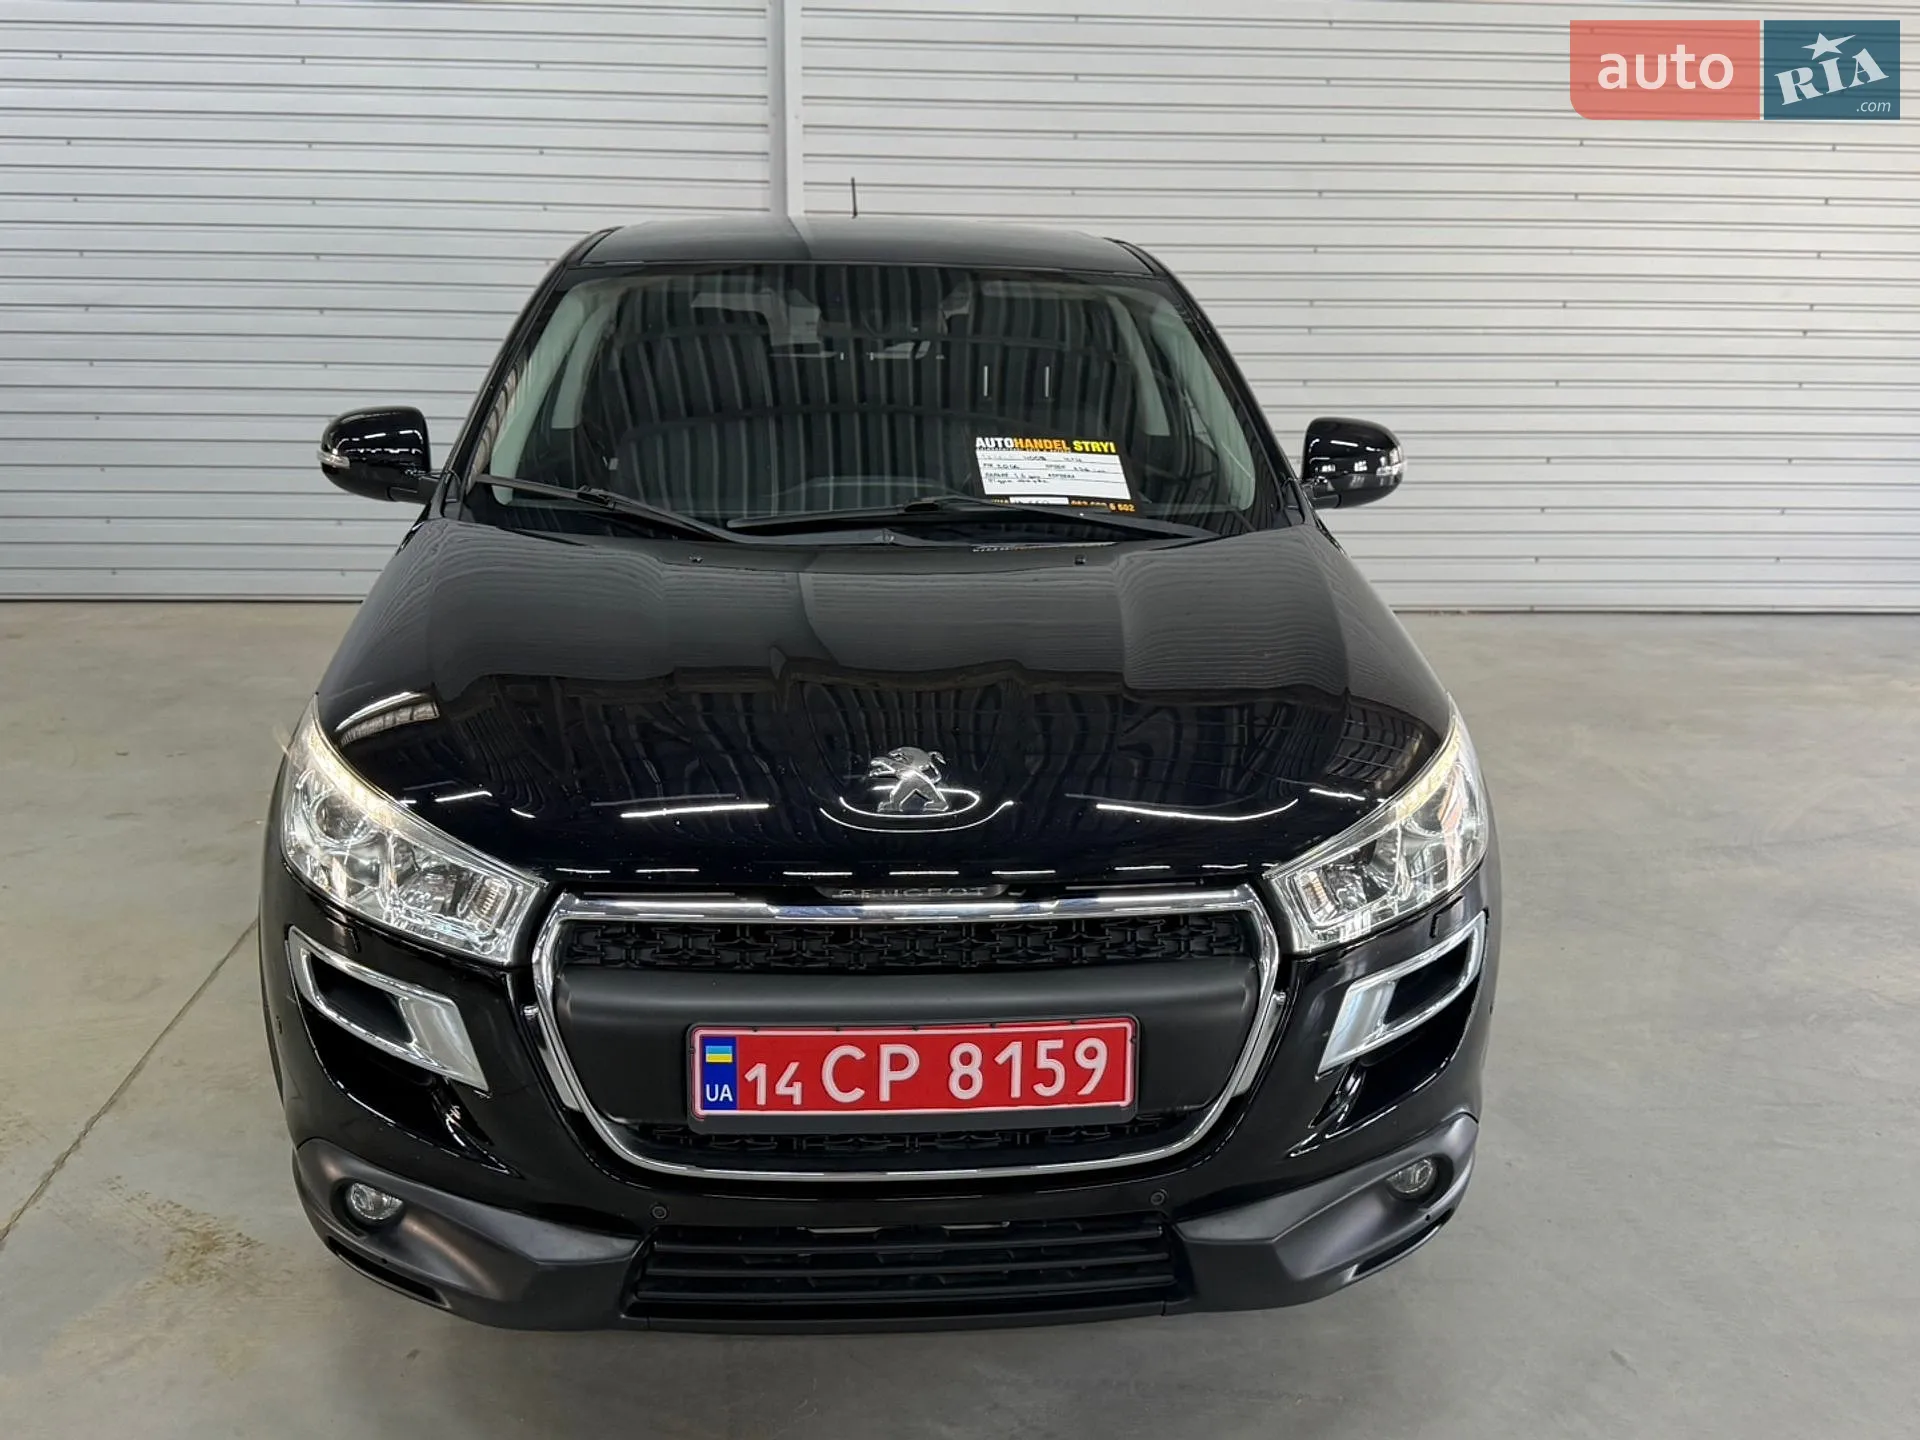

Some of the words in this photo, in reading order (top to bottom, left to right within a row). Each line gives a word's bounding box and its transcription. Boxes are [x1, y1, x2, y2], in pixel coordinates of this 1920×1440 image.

[975, 437, 1070, 451] AUTOHANDEL
[1073, 440, 1116, 453] STRYI
[838, 886, 987, 899] PEUGEOT
[744, 1061, 803, 1106] 14
[821, 1044, 921, 1103] CP
[949, 1037, 1109, 1101] 8159
[705, 1083, 734, 1103] UA
